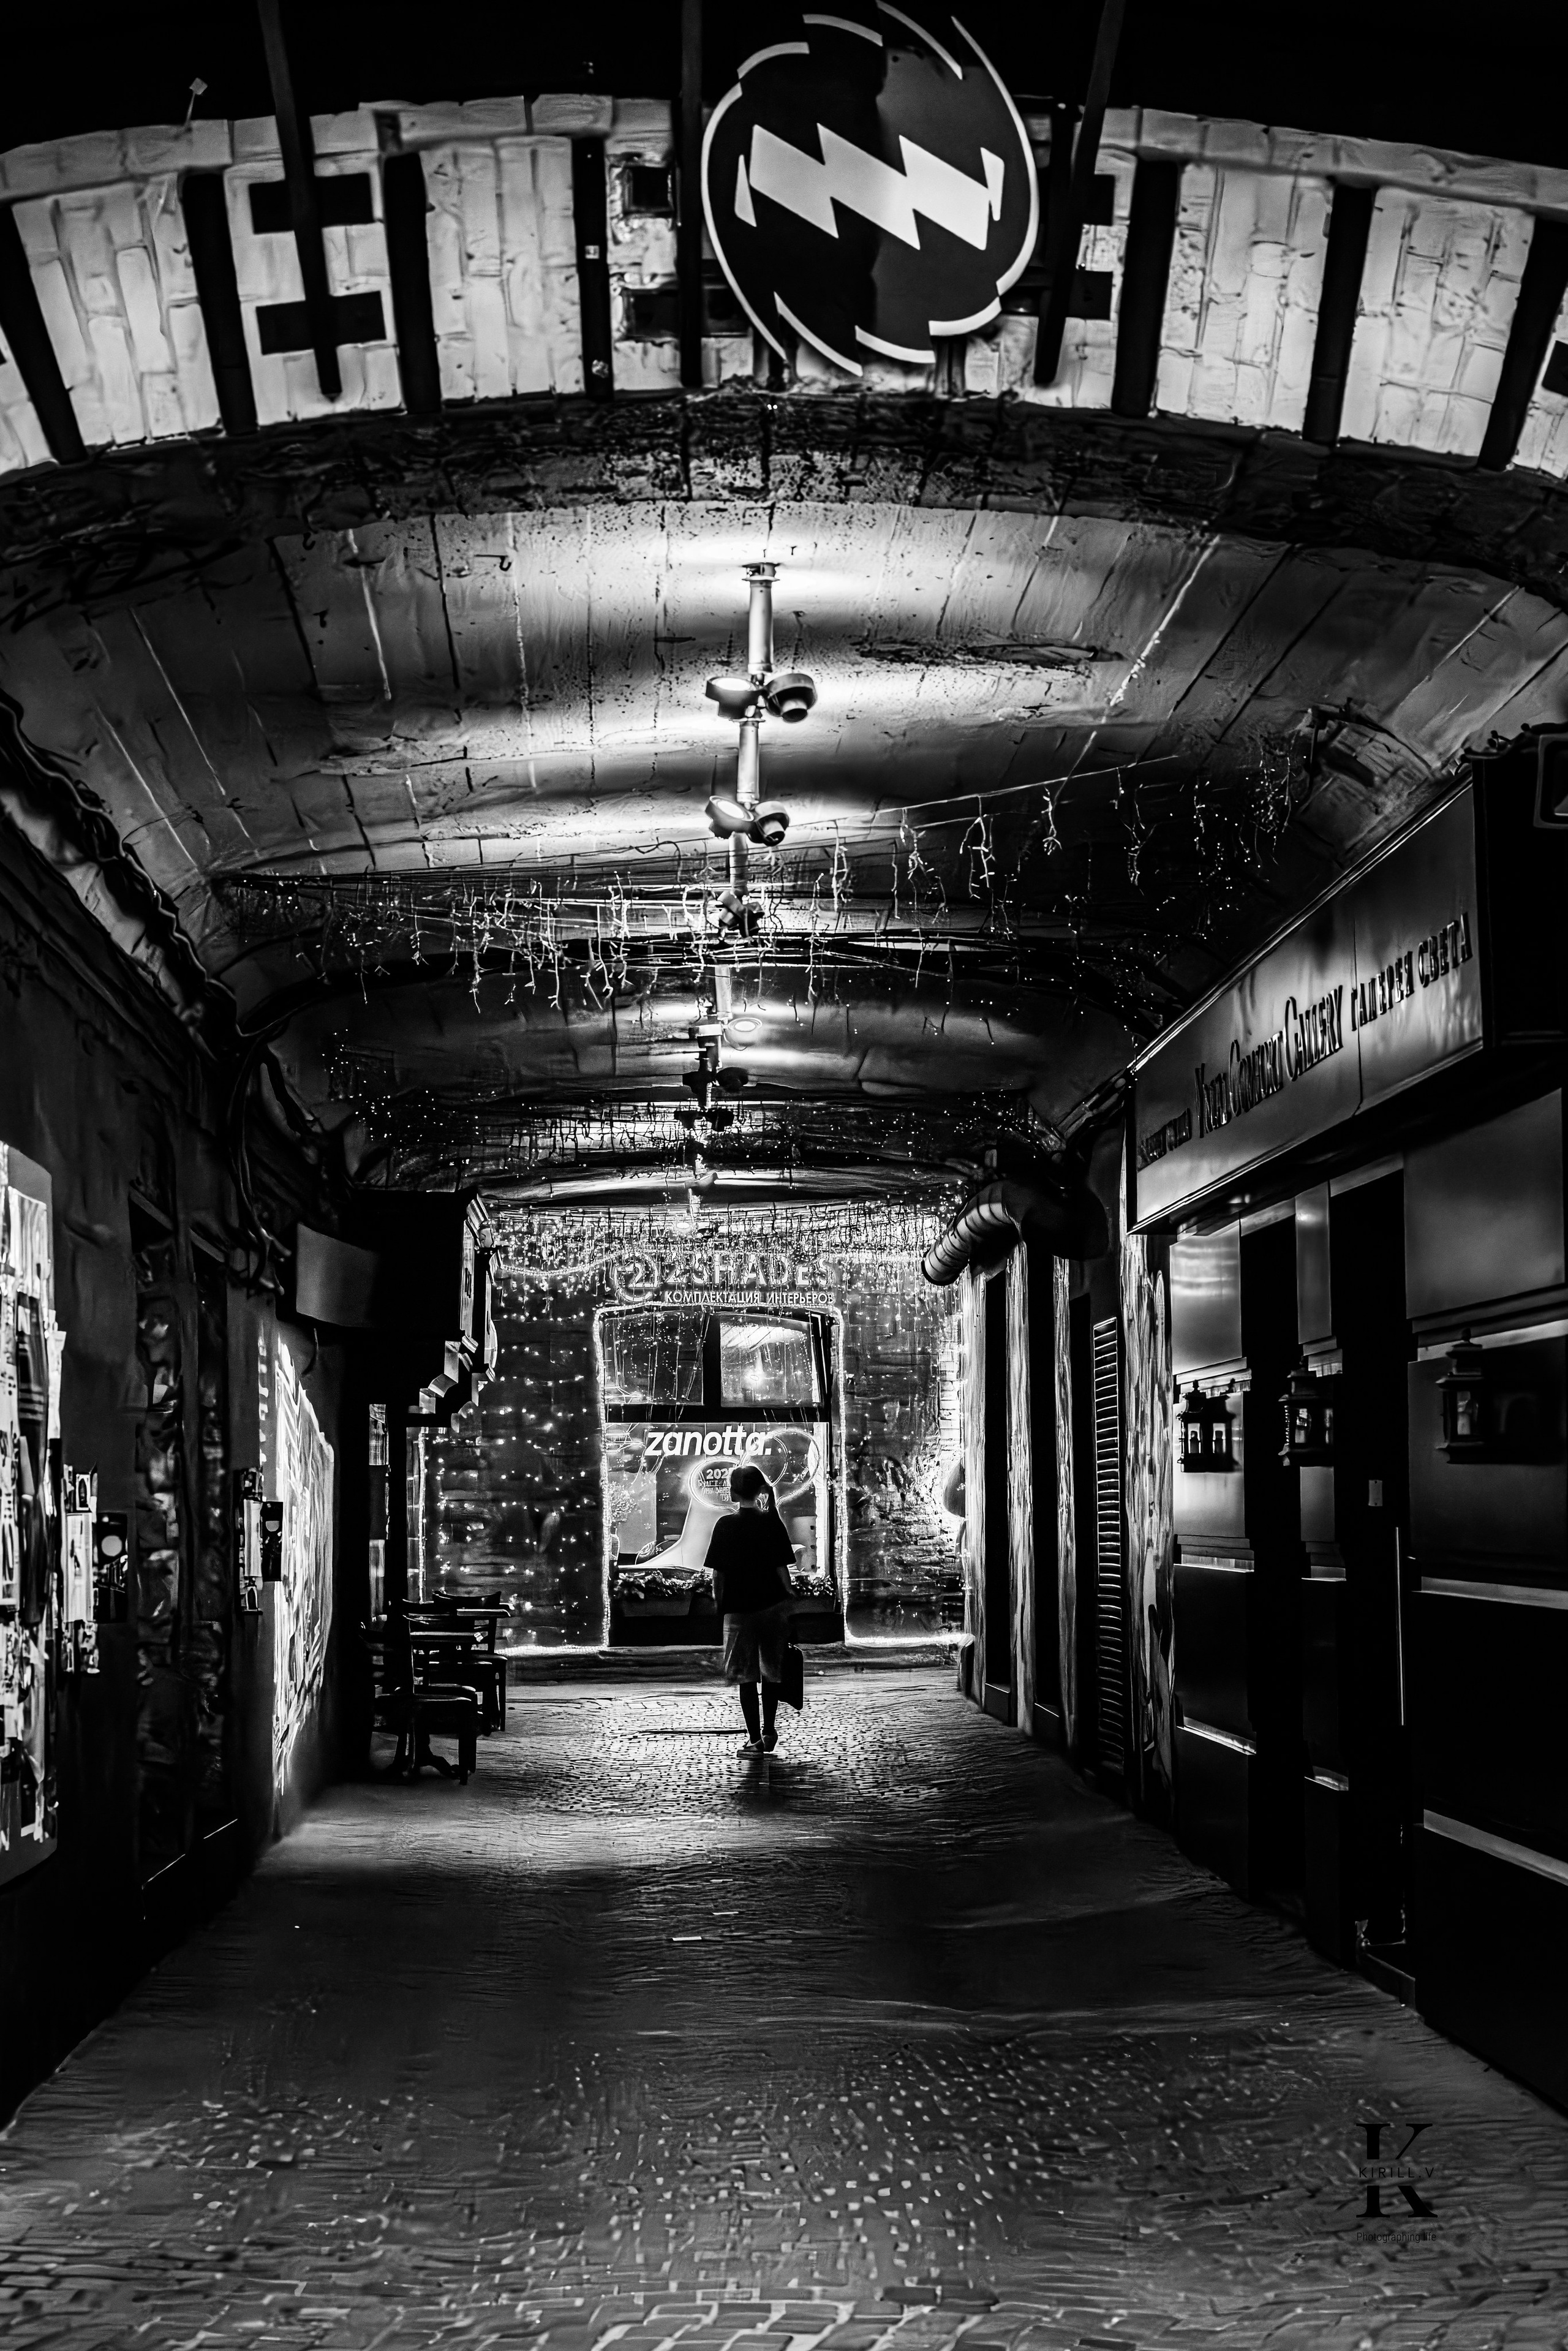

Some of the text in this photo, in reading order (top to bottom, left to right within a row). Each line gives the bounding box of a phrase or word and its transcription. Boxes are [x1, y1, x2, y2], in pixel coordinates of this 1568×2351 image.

[1418, 911, 1473, 988] СВЕТА
[1285, 984, 1344, 1082] GALLERY
[665, 1291, 835, 1304] КОМПЛЕКТАЦИЯ ИНТЕРЬЕРОВ
[706, 1468, 729, 1480] 202
